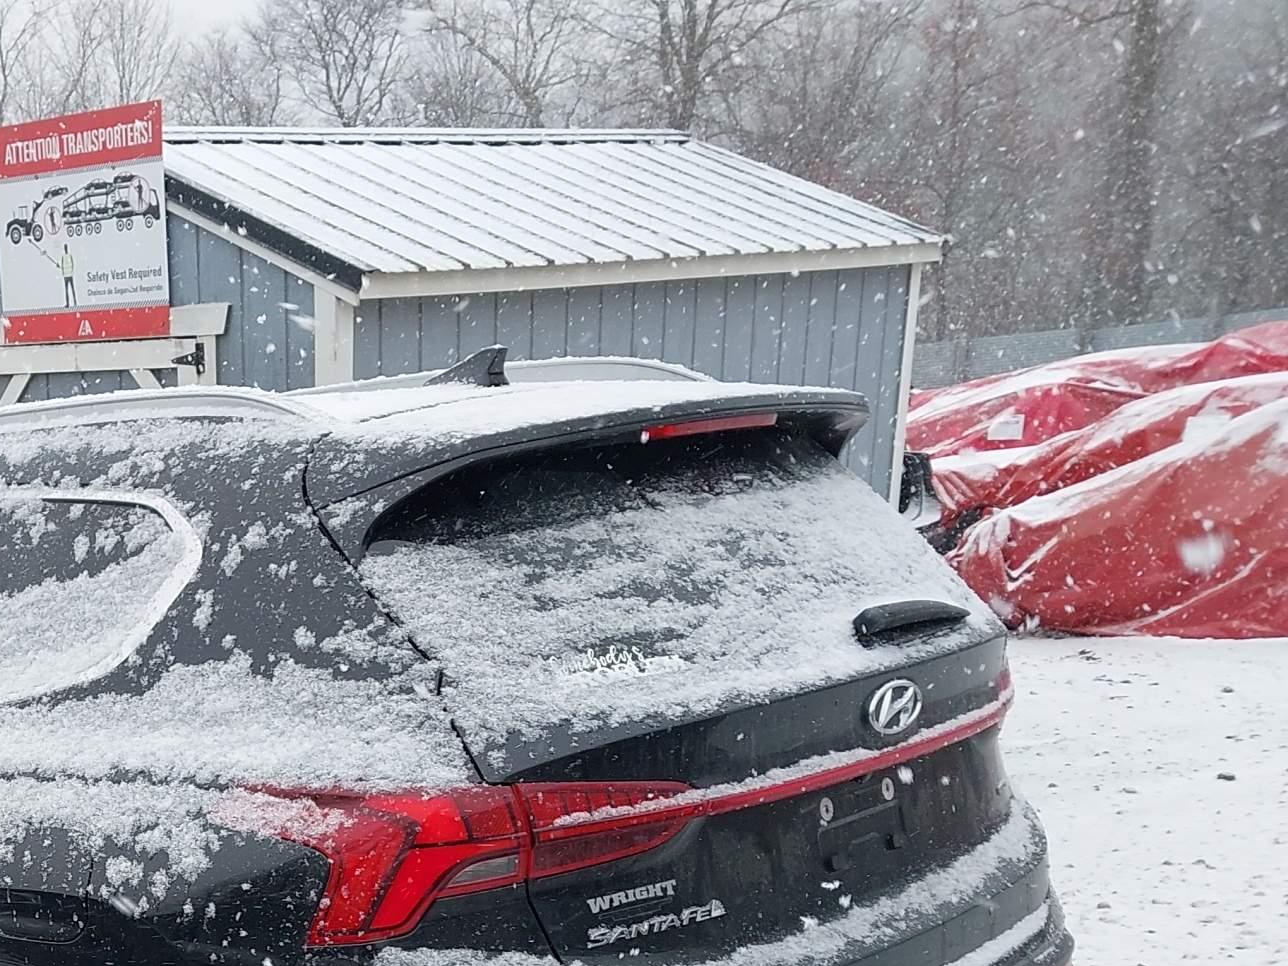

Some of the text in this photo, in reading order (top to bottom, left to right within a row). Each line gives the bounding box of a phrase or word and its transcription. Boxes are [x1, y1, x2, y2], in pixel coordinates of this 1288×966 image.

[5, 120, 153, 166] ATTENTION TRANSPORTERS!
[87, 265, 162, 284] Safety Vest Required
[586, 879, 677, 914] WRIGHT
[586, 903, 715, 949] SANTA FE
